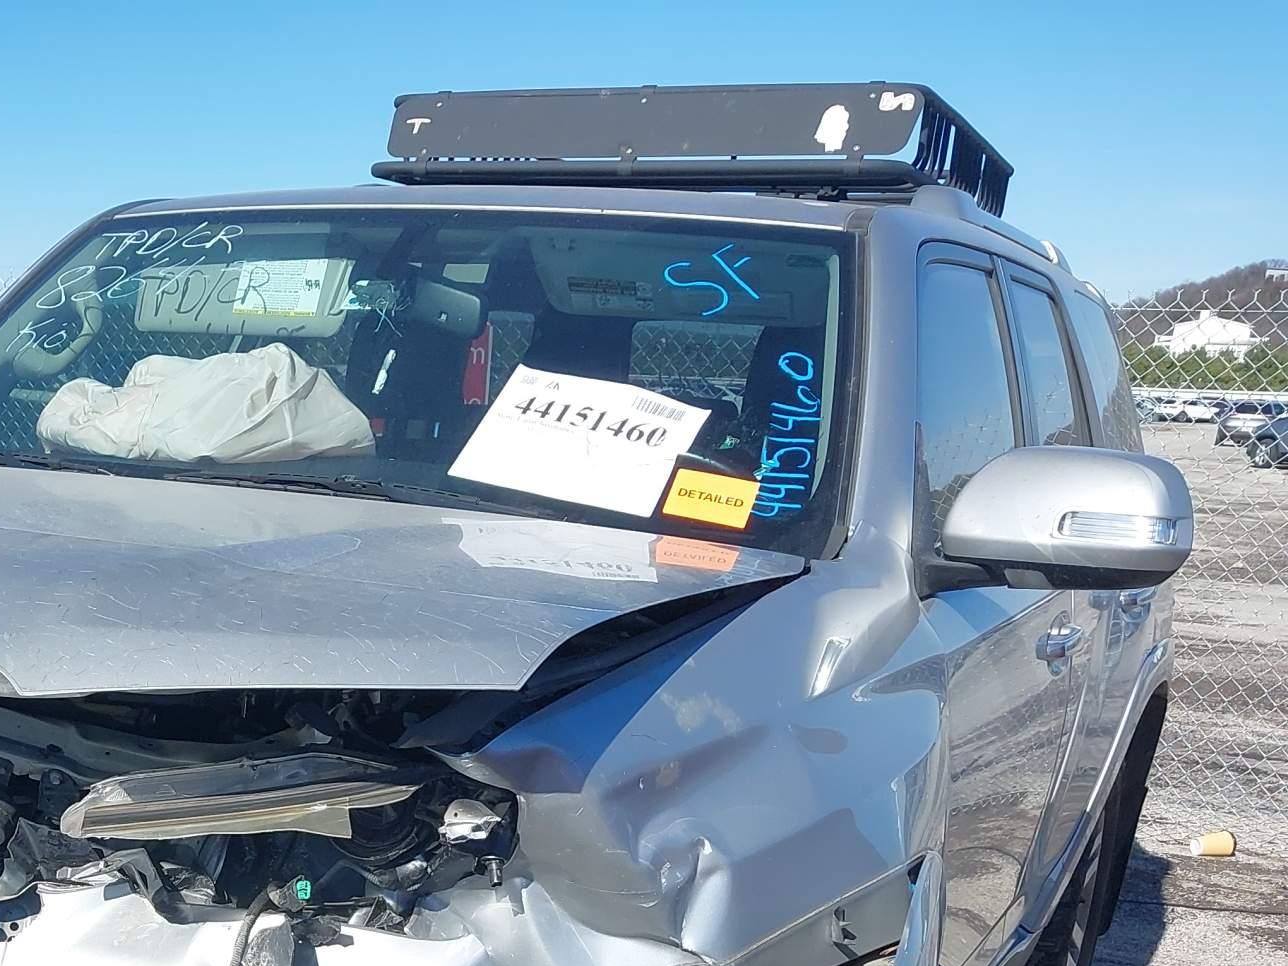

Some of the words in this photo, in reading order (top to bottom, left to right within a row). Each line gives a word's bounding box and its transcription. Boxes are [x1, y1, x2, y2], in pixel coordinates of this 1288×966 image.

[664, 244, 760, 316] SF
[515, 397, 668, 447] 44151460
[750, 352, 823, 517] 44151460
[678, 487, 744, 508] DETAILED
